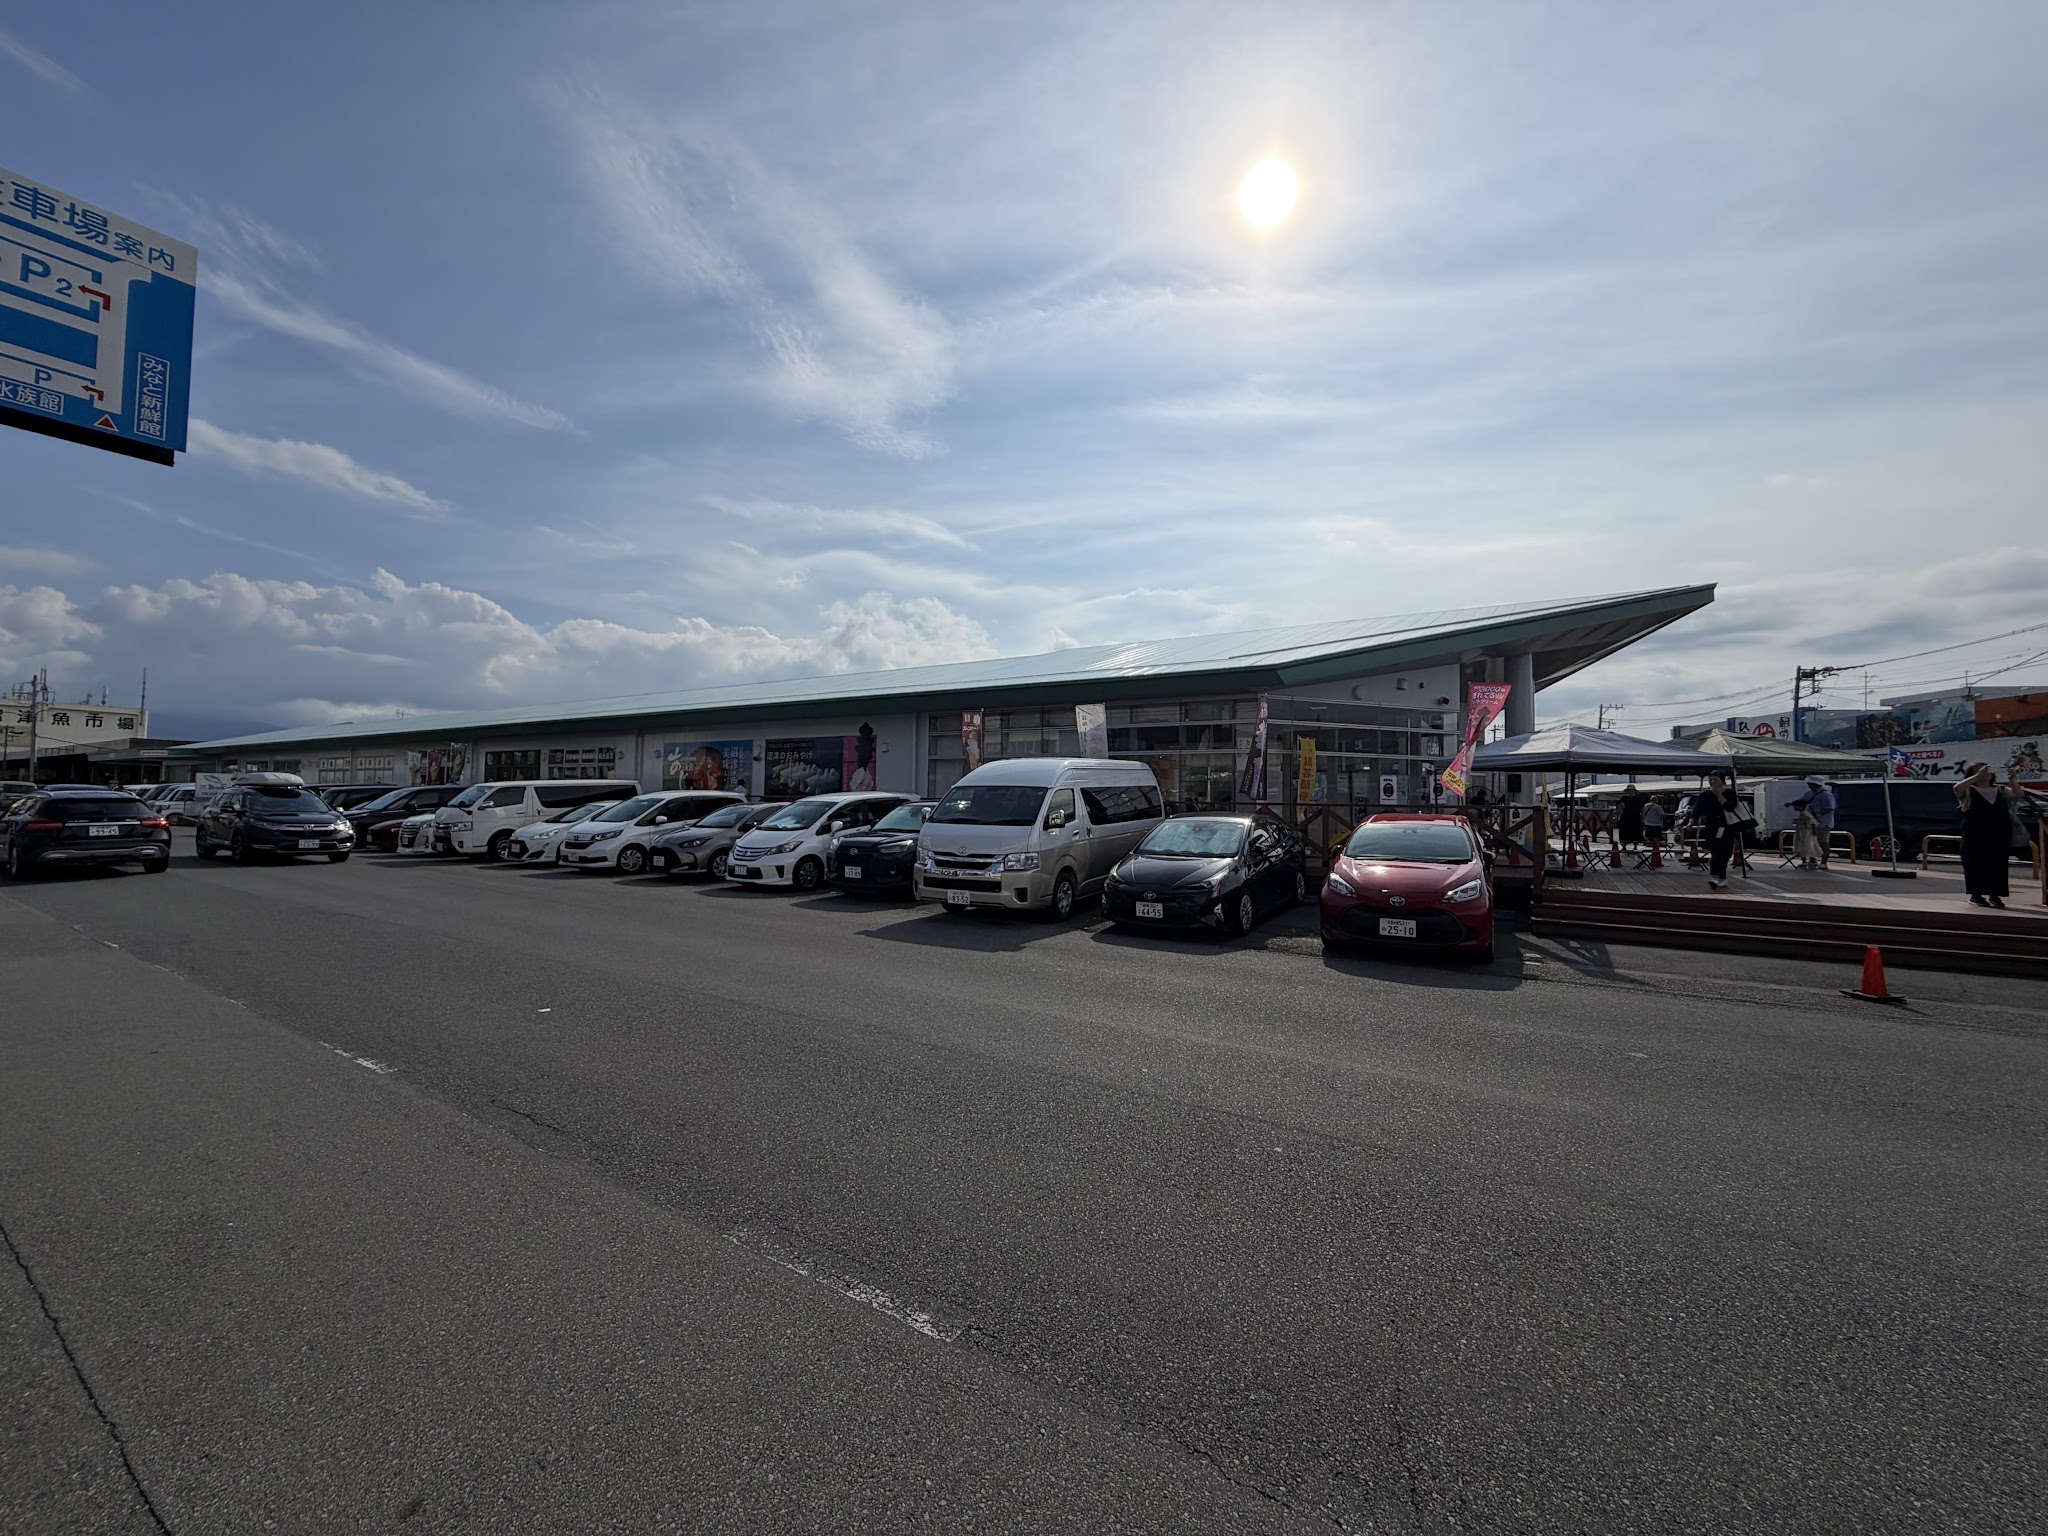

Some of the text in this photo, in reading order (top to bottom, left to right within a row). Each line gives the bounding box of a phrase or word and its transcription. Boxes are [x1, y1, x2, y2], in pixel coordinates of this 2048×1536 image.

[0, 180, 174, 272] 車場案内
[34, 368, 52, 384] P
[140, 356, 164, 436] みなと新鮮館
[0, 709, 134, 732] 津魚市場
[767, 751, 813, 761] 沼津のおみやげ
[1914, 760, 1966, 776] クルーズ
[1142, 908, 1162, 917] 64-55
[1388, 926, 1414, 935] 25-10
